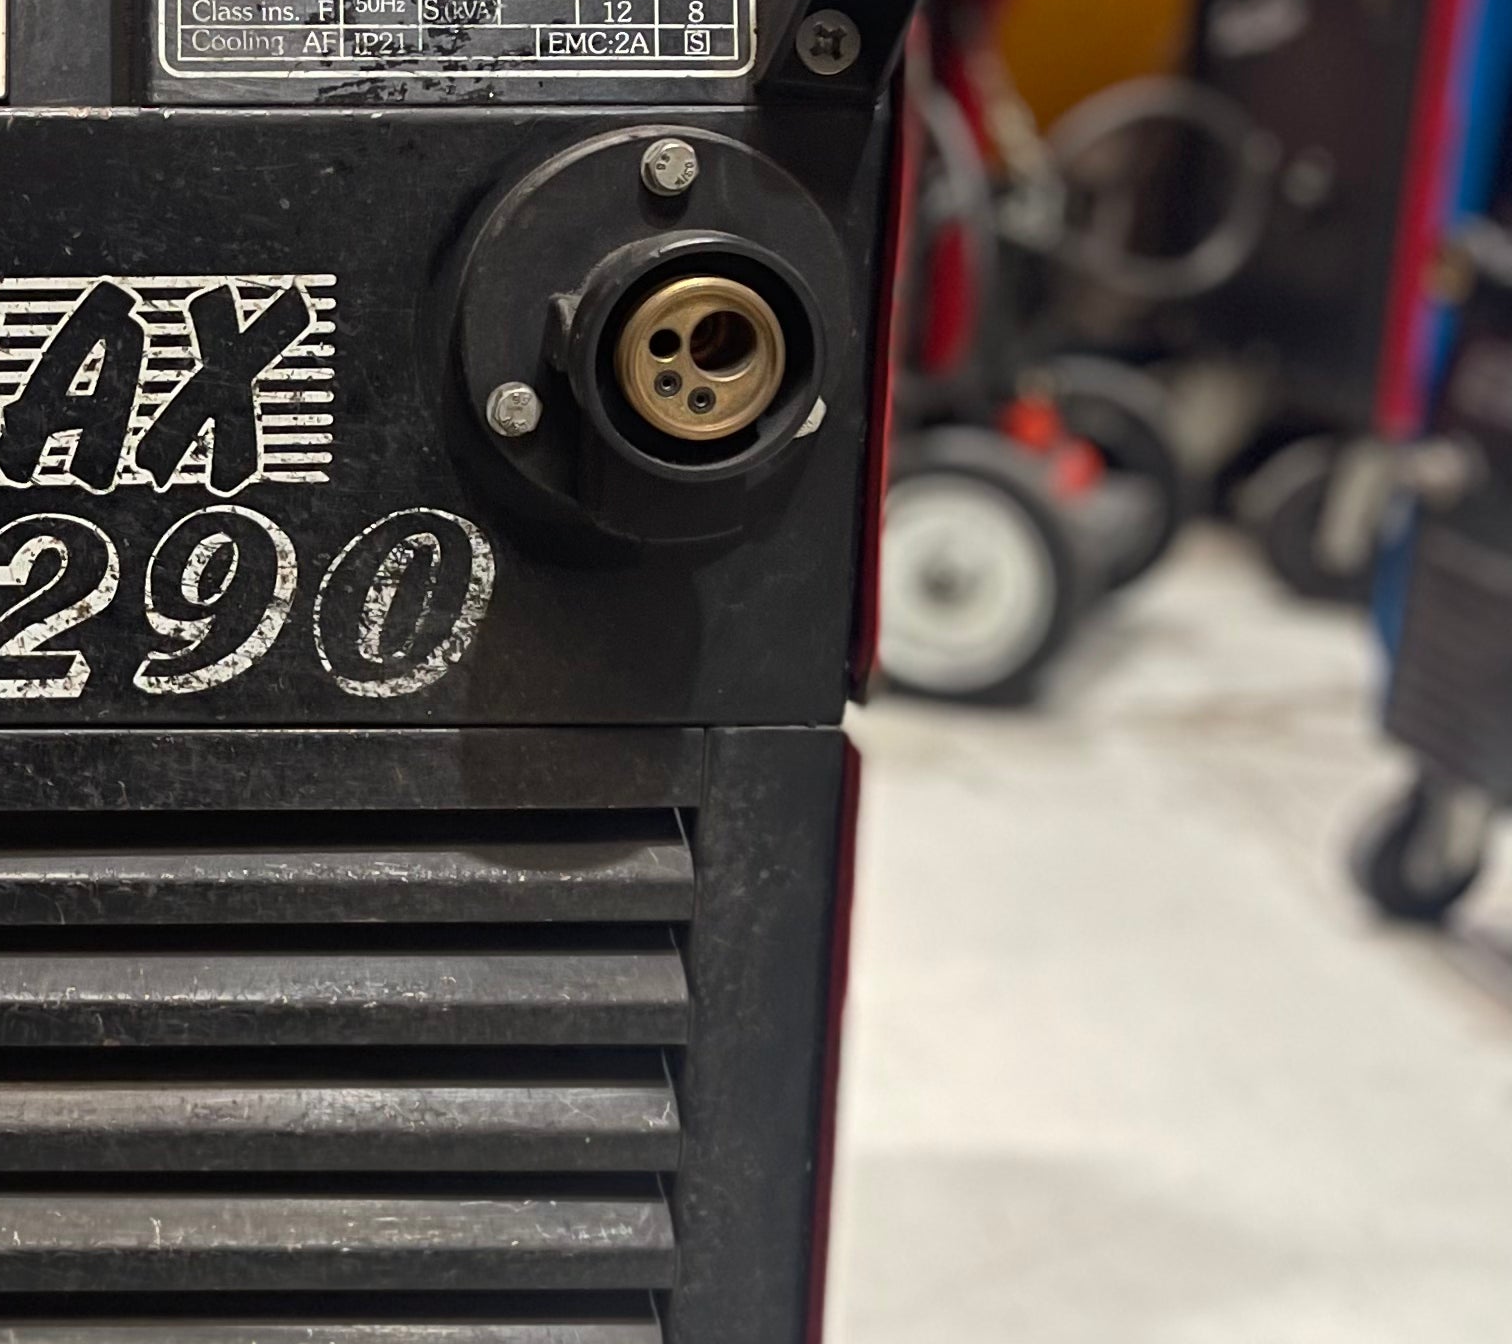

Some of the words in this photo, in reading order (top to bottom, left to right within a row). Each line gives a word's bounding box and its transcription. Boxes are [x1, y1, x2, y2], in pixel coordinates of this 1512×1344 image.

[192, 0, 253, 22] Class
[261, 0, 300, 22] ins.
[318, 0, 334, 21] F
[603, 1, 632, 23] 12
[688, 1, 704, 23] 8
[192, 31, 283, 56] Cooling
[303, 31, 337, 54] AF
[354, 32, 405, 55] IP21
[548, 32, 650, 55] EMC:2A
